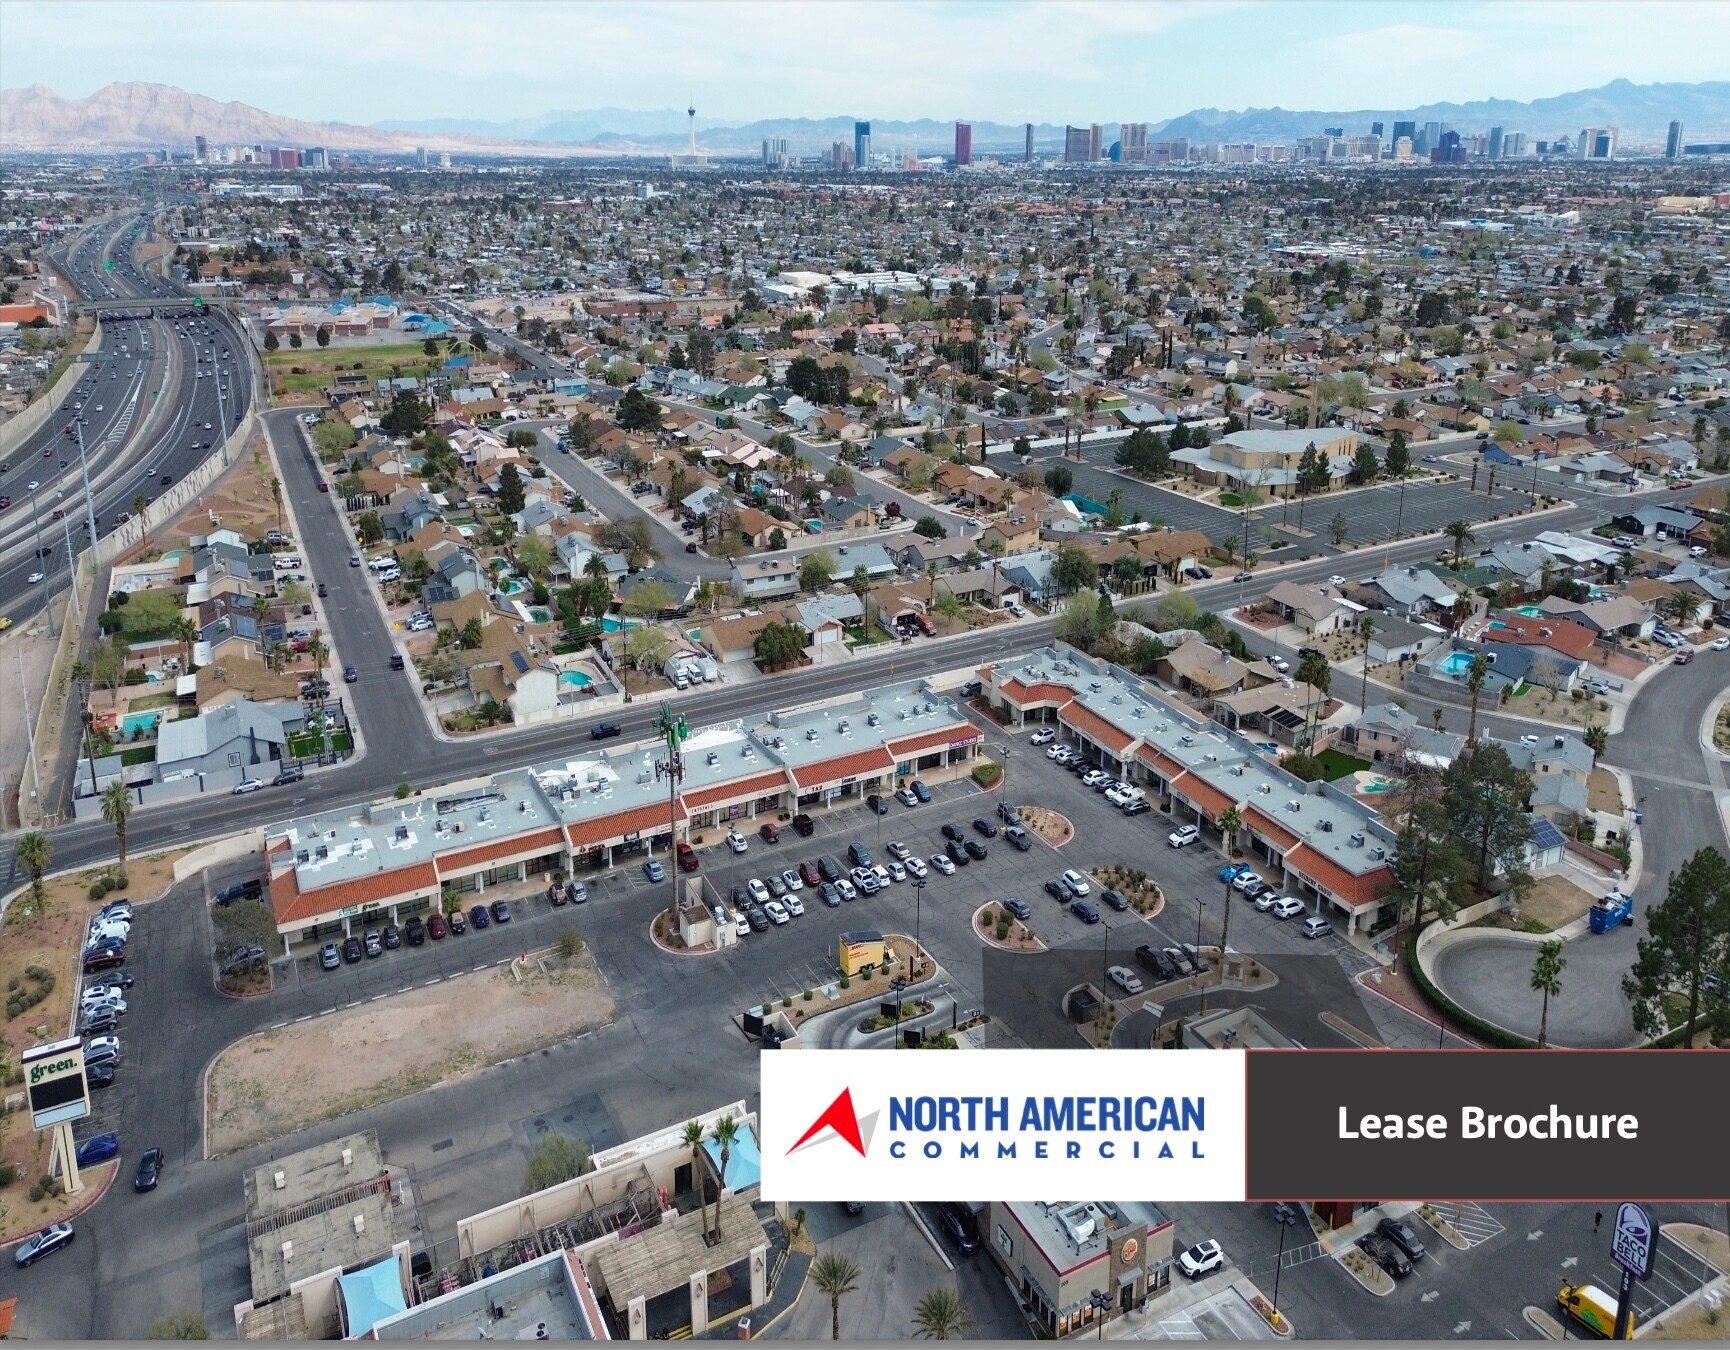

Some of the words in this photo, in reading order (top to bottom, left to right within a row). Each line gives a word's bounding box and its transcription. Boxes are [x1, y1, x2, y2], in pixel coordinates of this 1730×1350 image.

[30, 1057, 78, 1084] green.
[1616, 1228, 1646, 1258] TACO
[1616, 1241, 1644, 1269] BELL
